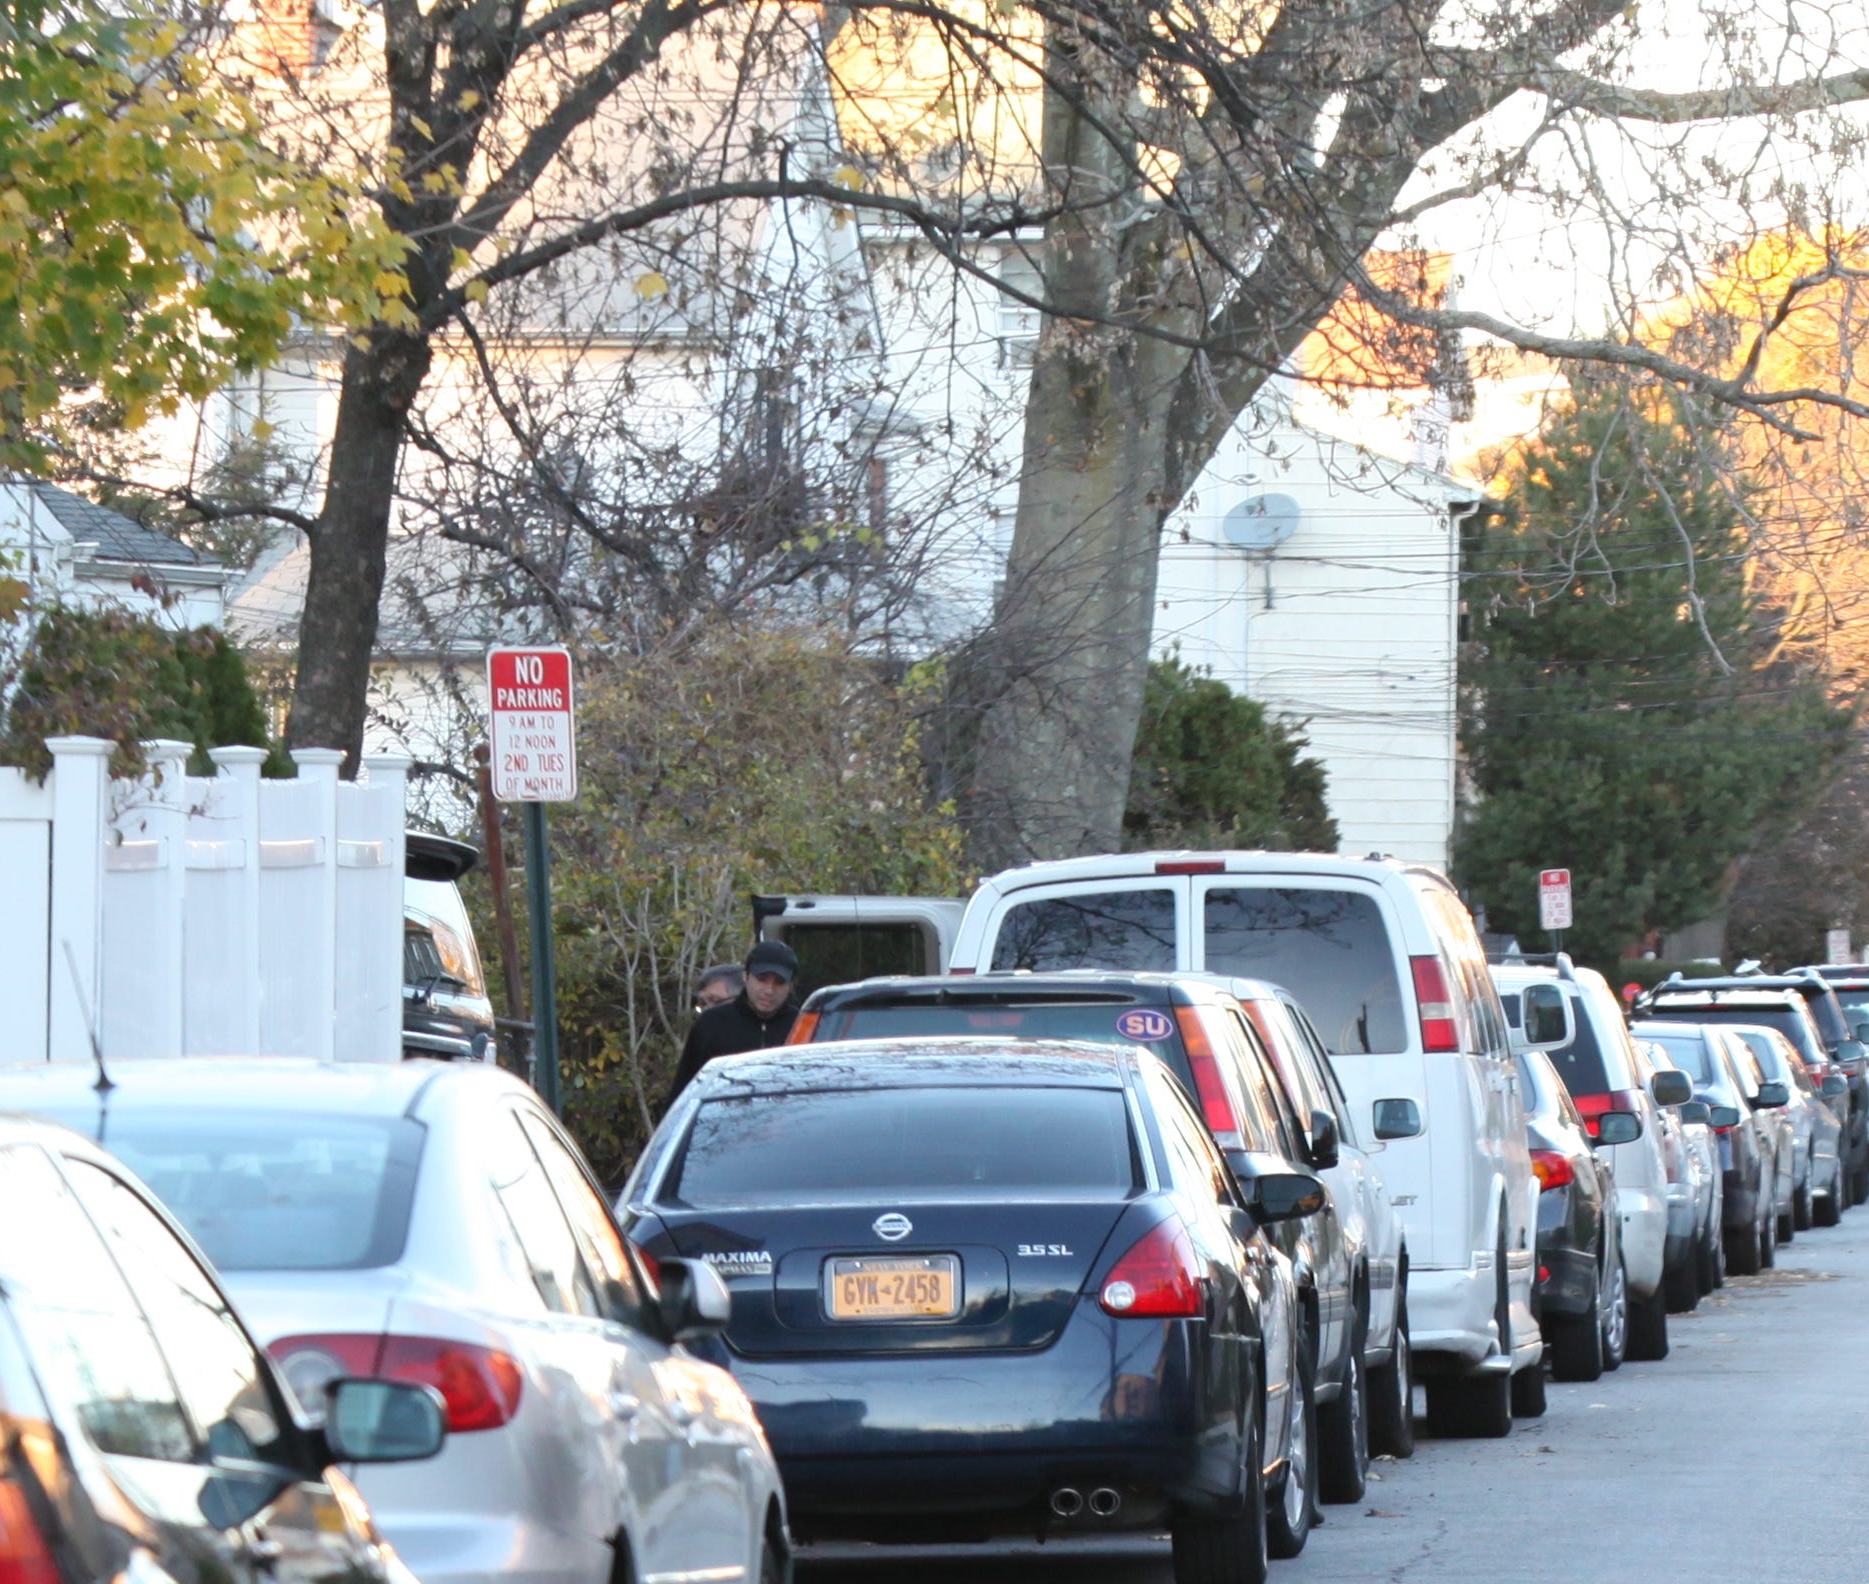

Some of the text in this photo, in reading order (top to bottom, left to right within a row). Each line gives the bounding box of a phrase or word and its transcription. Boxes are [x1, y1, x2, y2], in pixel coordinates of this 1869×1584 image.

[515, 656, 543, 684] NO
[497, 688, 563, 708] PARKING
[509, 716, 555, 729] 9 AM TO
[510, 735, 556, 748] 12 NOON
[504, 754, 564, 772] 2ND TUES
[506, 777, 563, 791] OF MONTH
[1126, 1015, 1165, 1035] SU
[701, 1250, 772, 1263] MAXIMA
